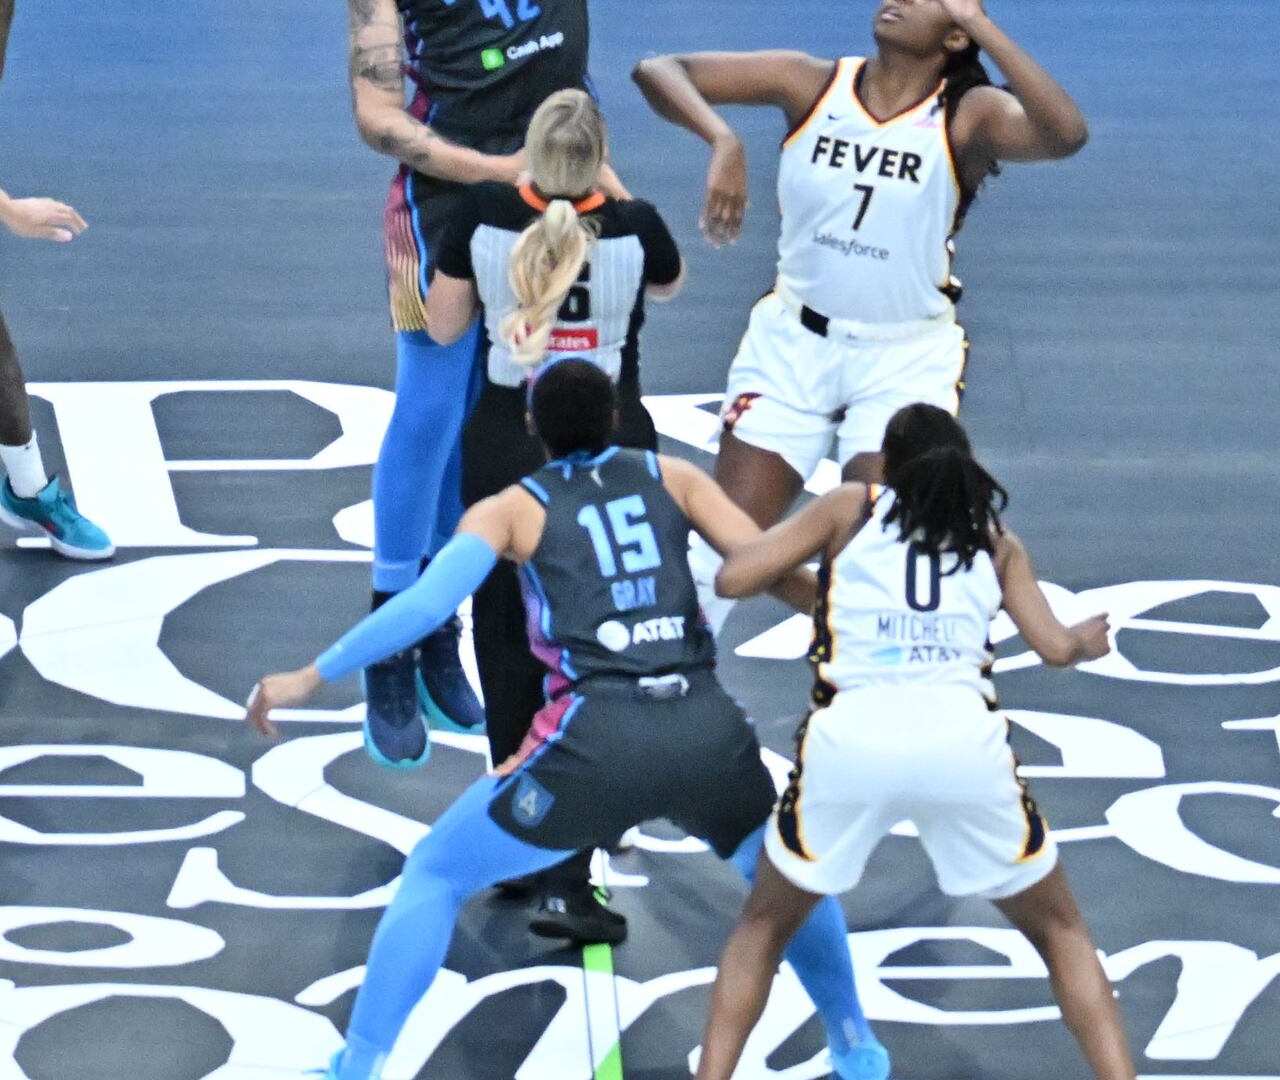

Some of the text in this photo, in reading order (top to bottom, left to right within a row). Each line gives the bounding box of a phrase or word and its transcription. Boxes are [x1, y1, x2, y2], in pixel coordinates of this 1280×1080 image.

[507, 39, 540, 59] Cash
[811, 134, 922, 184] FEVER
[852, 183, 874, 231] 7
[813, 230, 890, 261] salesforce
[577, 494, 663, 578] 15
[904, 539, 941, 612] 0
[633, 616, 685, 645] AT&T
